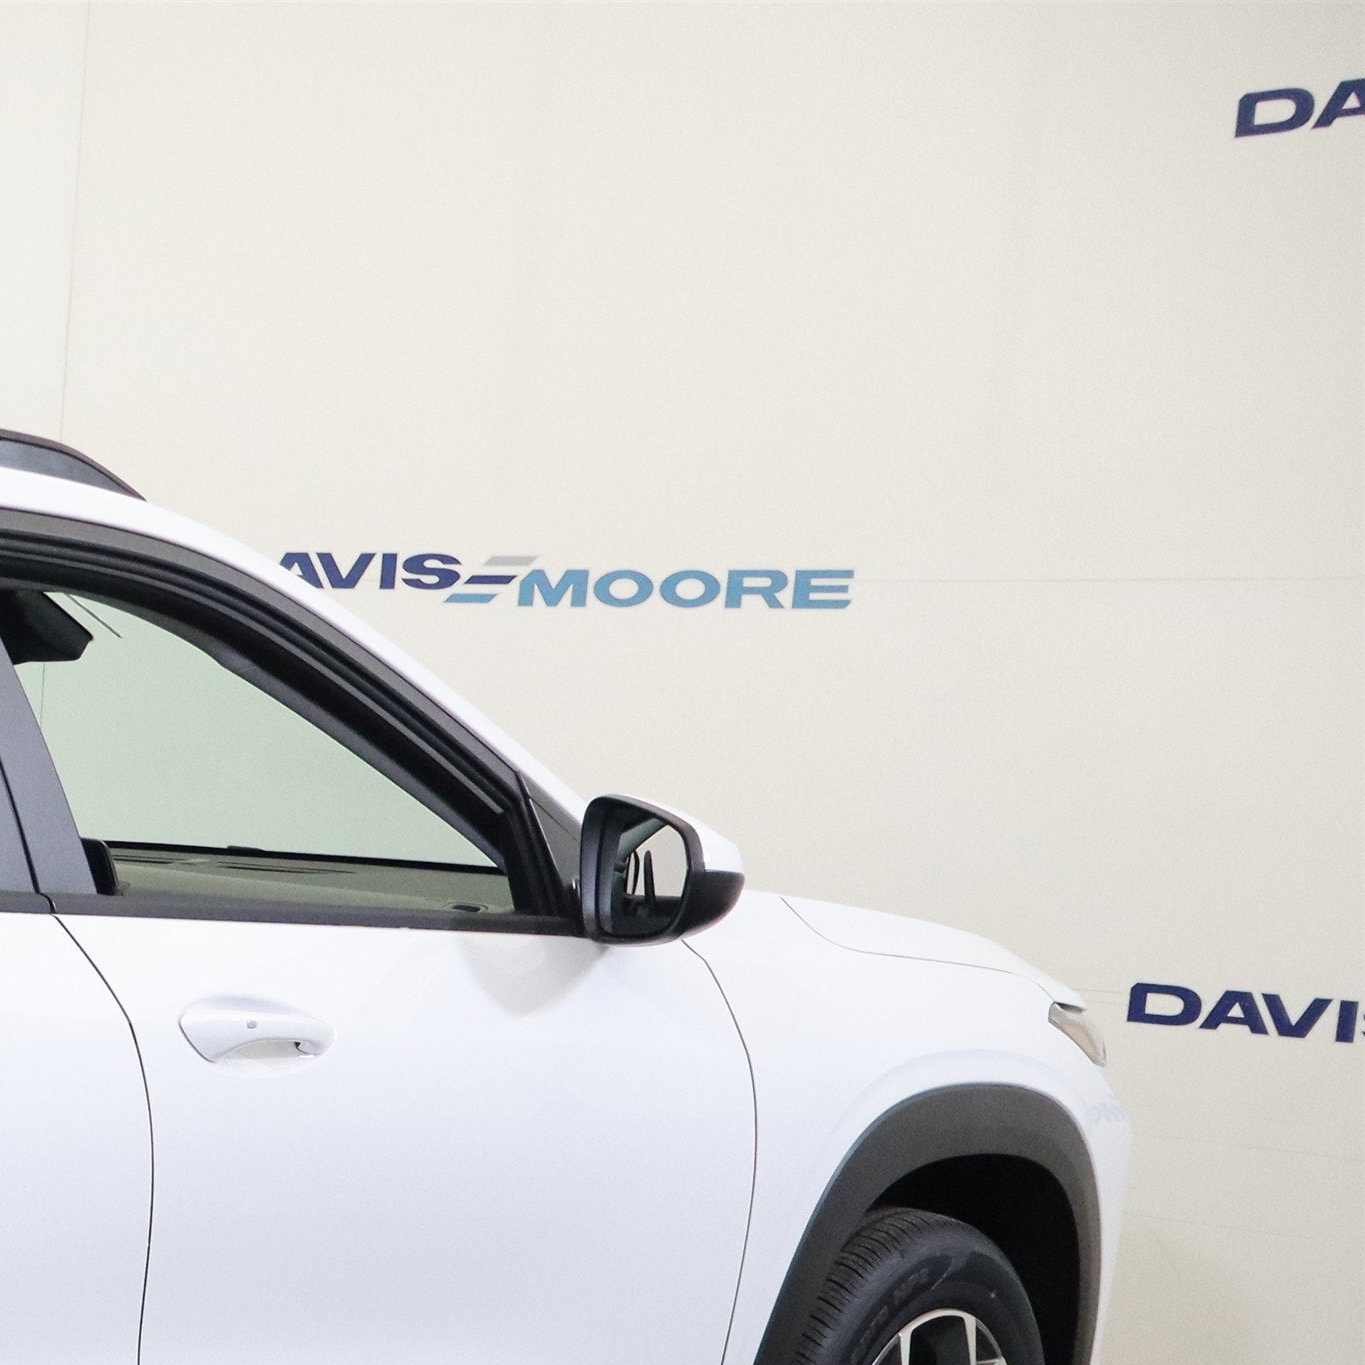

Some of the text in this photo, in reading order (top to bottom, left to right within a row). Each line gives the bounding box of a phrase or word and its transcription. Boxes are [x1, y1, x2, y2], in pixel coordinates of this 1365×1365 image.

[1234, 77, 1365, 138] DA
[279, 552, 855, 609] AVIS MOORE
[1126, 982, 1365, 1043] DAVI
